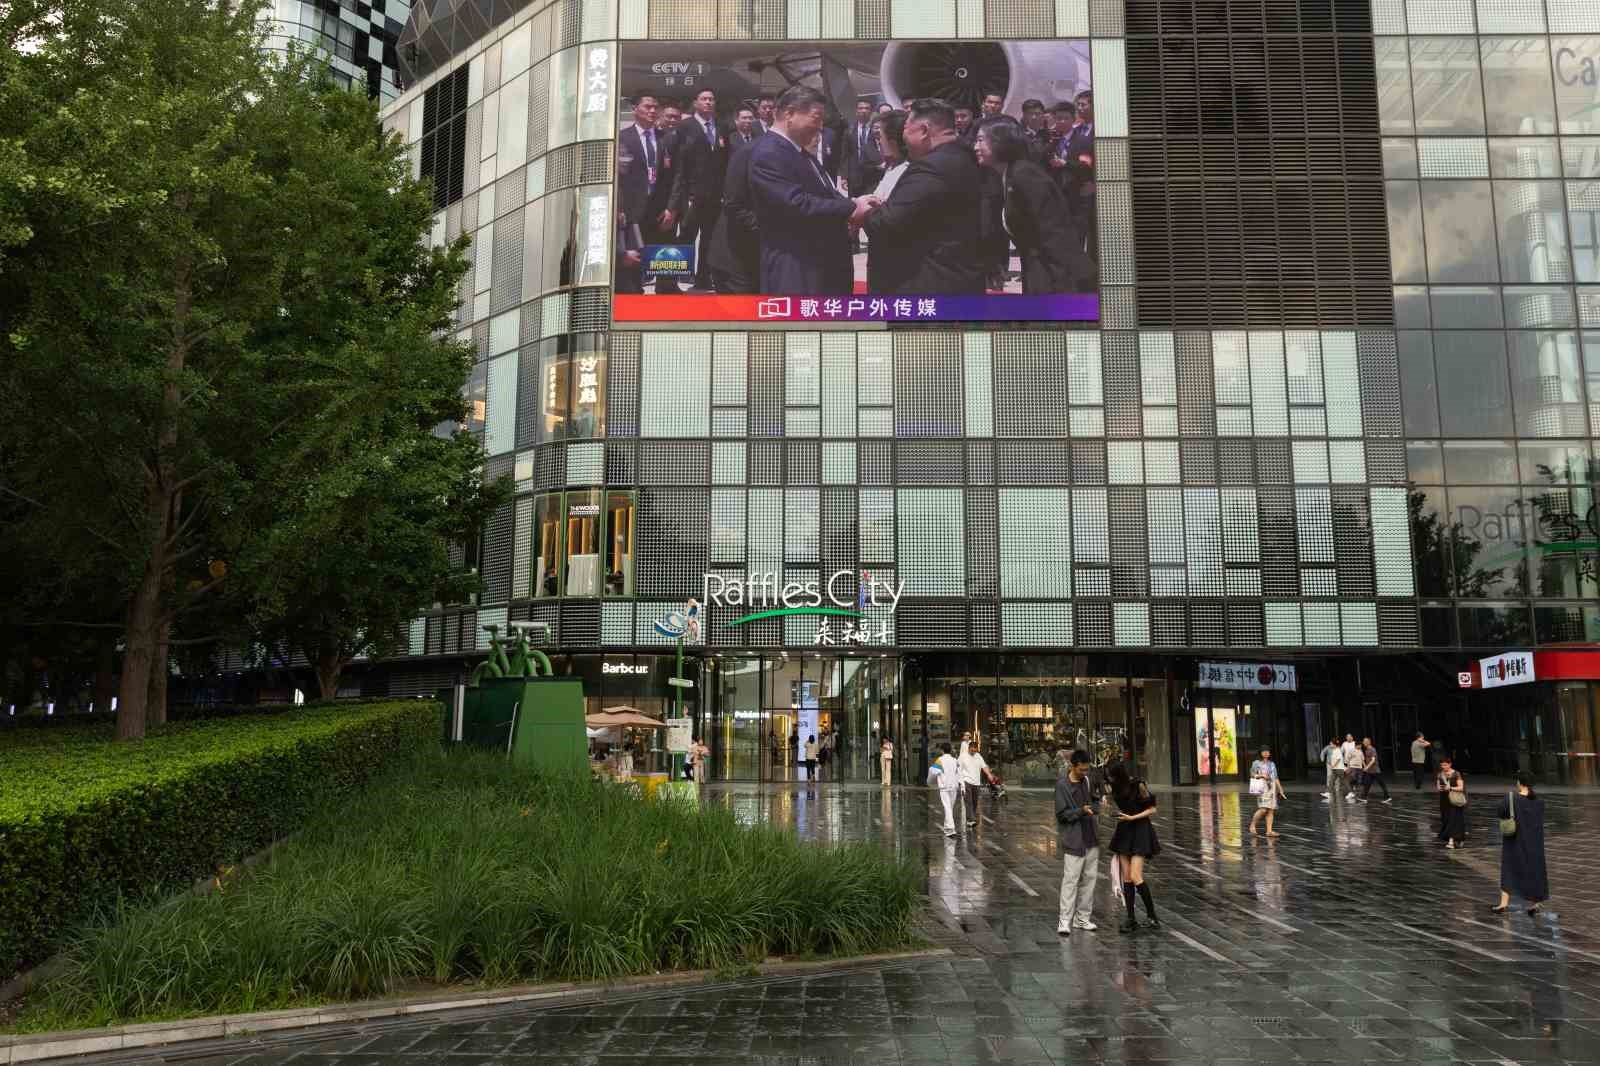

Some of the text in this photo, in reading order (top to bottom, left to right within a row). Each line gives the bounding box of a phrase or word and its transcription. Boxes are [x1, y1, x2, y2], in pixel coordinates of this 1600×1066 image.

[800, 298, 937, 318] 歌华户外传媒
[703, 570, 906, 613] Raffles City
[814, 616, 894, 645] 来福士
